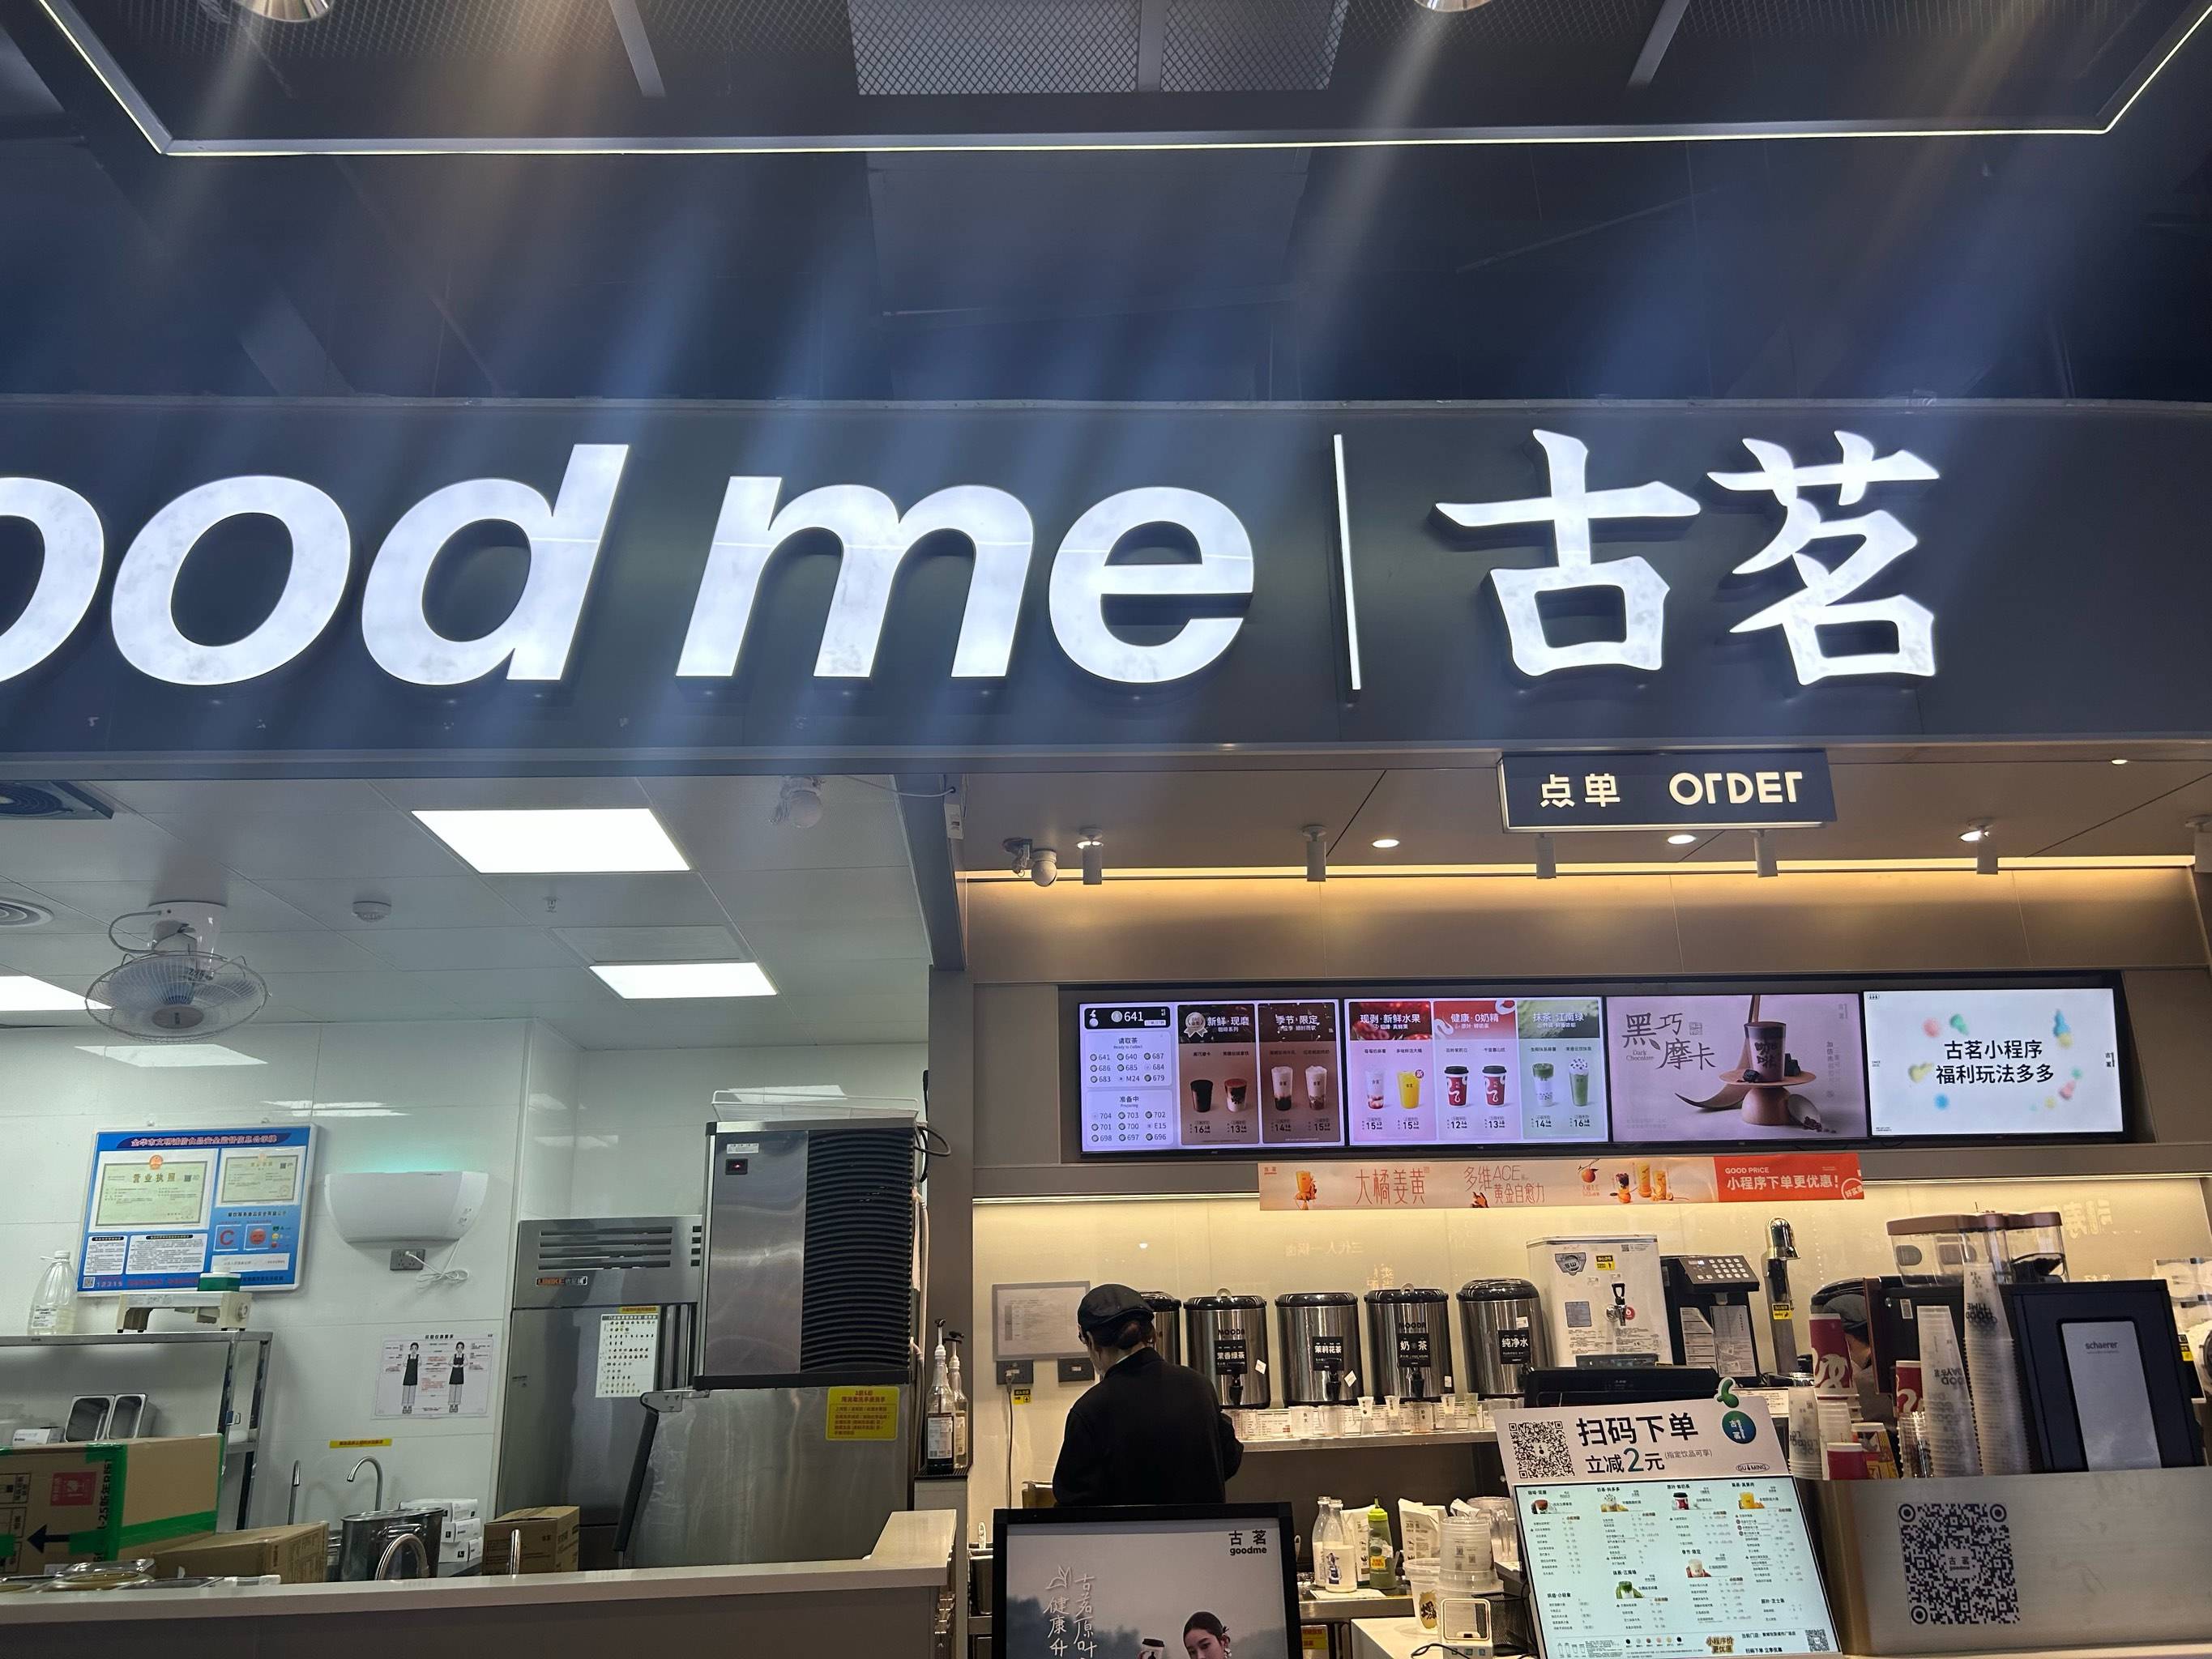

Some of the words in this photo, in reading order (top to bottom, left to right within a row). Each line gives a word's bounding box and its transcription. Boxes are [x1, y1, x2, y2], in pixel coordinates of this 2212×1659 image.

[1435, 429, 1941, 687] 古茗
[676, 476, 1255, 685] me
[1540, 774, 1621, 808] 点单
[1124, 1011, 1144, 1021] 641
[1621, 1013, 1684, 1049] 黑巧
[1655, 1038, 1716, 1071] 摩卡
[1944, 1039, 2043, 1060] 古茗小程序
[1936, 1064, 2054, 1085] 福利玩法多多
[133, 1172, 176, 1183] 营业执照
[1463, 1165, 1521, 1192] 多维ACE
[1724, 1166, 1747, 1175] GOOD
[1748, 1166, 1770, 1174] PRICE
[1355, 1167, 1426, 1205] 大橘姜黄
[1493, 1183, 1545, 1204] 黄金自愈力
[220, 1229, 234, 1246] C
[1314, 1346, 1342, 1354] 茉莉花茶
[1400, 1340, 1428, 1351] 奶茶
[1501, 1337, 1529, 1348] 纯净水
[2085, 1341, 2118, 1350] schaerer
[1576, 1412, 1699, 1447] 扫码下单
[1585, 1448, 1666, 1475] 立减2元
[1228, 1529, 1266, 1546] 古茗
[1229, 1546, 1267, 1556] goodme
[1074, 1574, 1098, 1659] 古茗原叶
